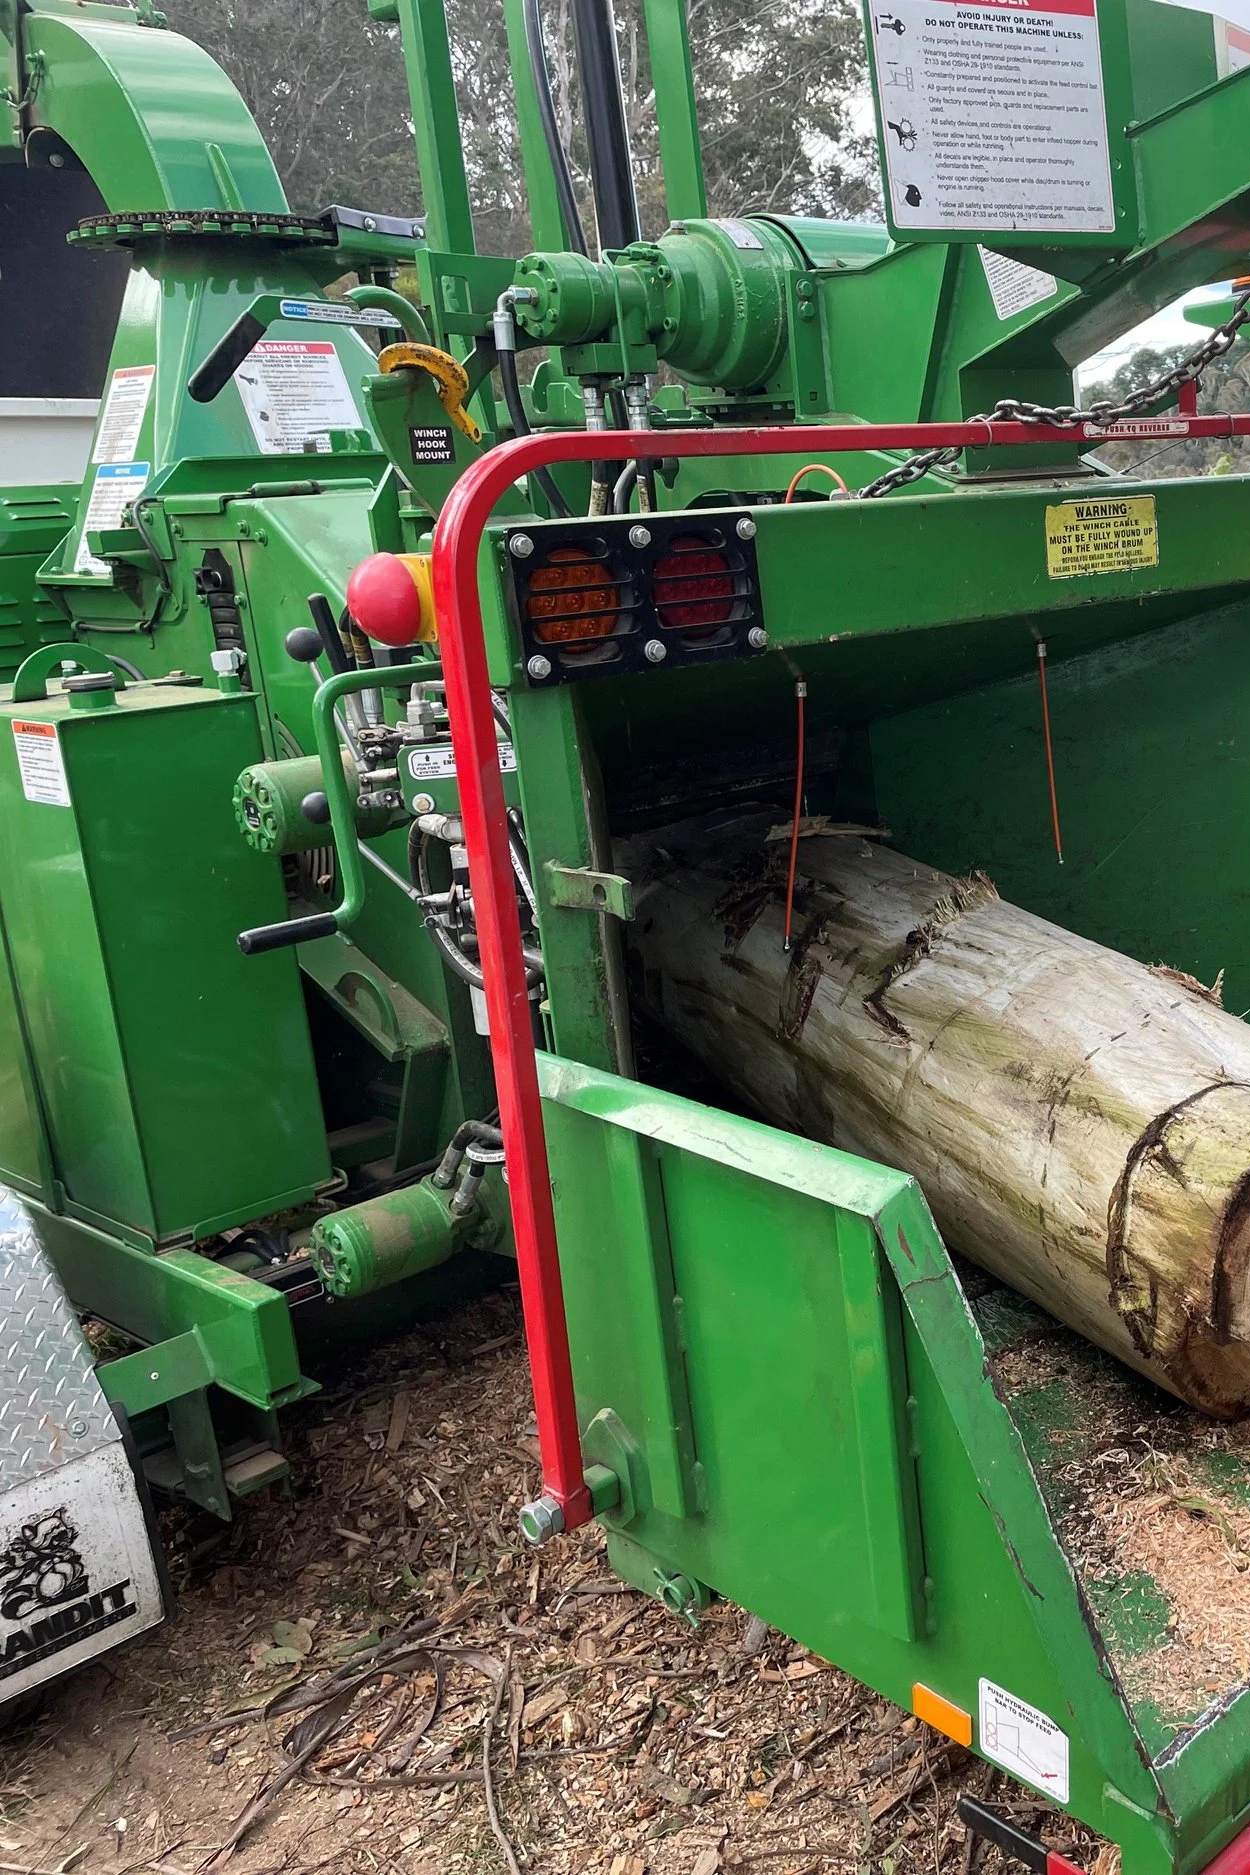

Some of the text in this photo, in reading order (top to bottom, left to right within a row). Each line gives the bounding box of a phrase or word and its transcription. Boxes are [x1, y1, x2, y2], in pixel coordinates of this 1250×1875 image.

[957, 11, 981, 20] AVOID
[983, 14, 1012, 23] INJURY
[1026, 18, 1054, 27] DEATH!
[939, 20, 956, 28] NOT
[958, 22, 994, 32] OPERATE
[996, 25, 1014, 34] THIS
[1016, 27, 1051, 37] MACHINE
[1053, 30, 1084, 40] UNLESS:
[922, 36, 936, 45] Only
[937, 38, 959, 47] properly
[972, 41, 984, 49] fully
[1004, 43, 1022, 52] people
[923, 49, 947, 58] Wearing
[948, 51, 970, 60] clothing
[982, 54, 1006, 63] personal
[1006, 56, 1032, 65] protective
[1033, 58, 1061, 67] equipment
[957, 74, 981, 82] prepared
[994, 76, 1021, 85] positioned
[936, 84, 955, 93] guards
[928, 97, 942, 105] Only
[943, 98, 961, 106] factory
[962, 99, 988, 108] approved
[1003, 102, 1022, 110] guards
[1034, 104, 1066, 113] replacement
[284, 305, 307, 314] NOTICE
[266, 344, 308, 352] DANGER
[1105, 424, 1124, 433] PUSH
[1064, 524, 1080, 532] THE
[1083, 522, 1111, 530] WINCH
[1050, 535, 1072, 545] MUST
[1076, 534, 1085, 542] BE
[1089, 532, 1110, 541] FULLY
[1114, 530, 1140, 538] WOUND
[1062, 546, 1072, 554] ON
[1076, 544, 1090, 553] THE
[1094, 541, 1119, 551] WINCH
[1053, 565, 1070, 573] FAILURE
[0, 1577, 130, 1661] ANDIT
[987, 1686, 1059, 1732] PUSH HYDRAULIC BUMP
[995, 1698, 1052, 1736] BAR TO STOP FEED
